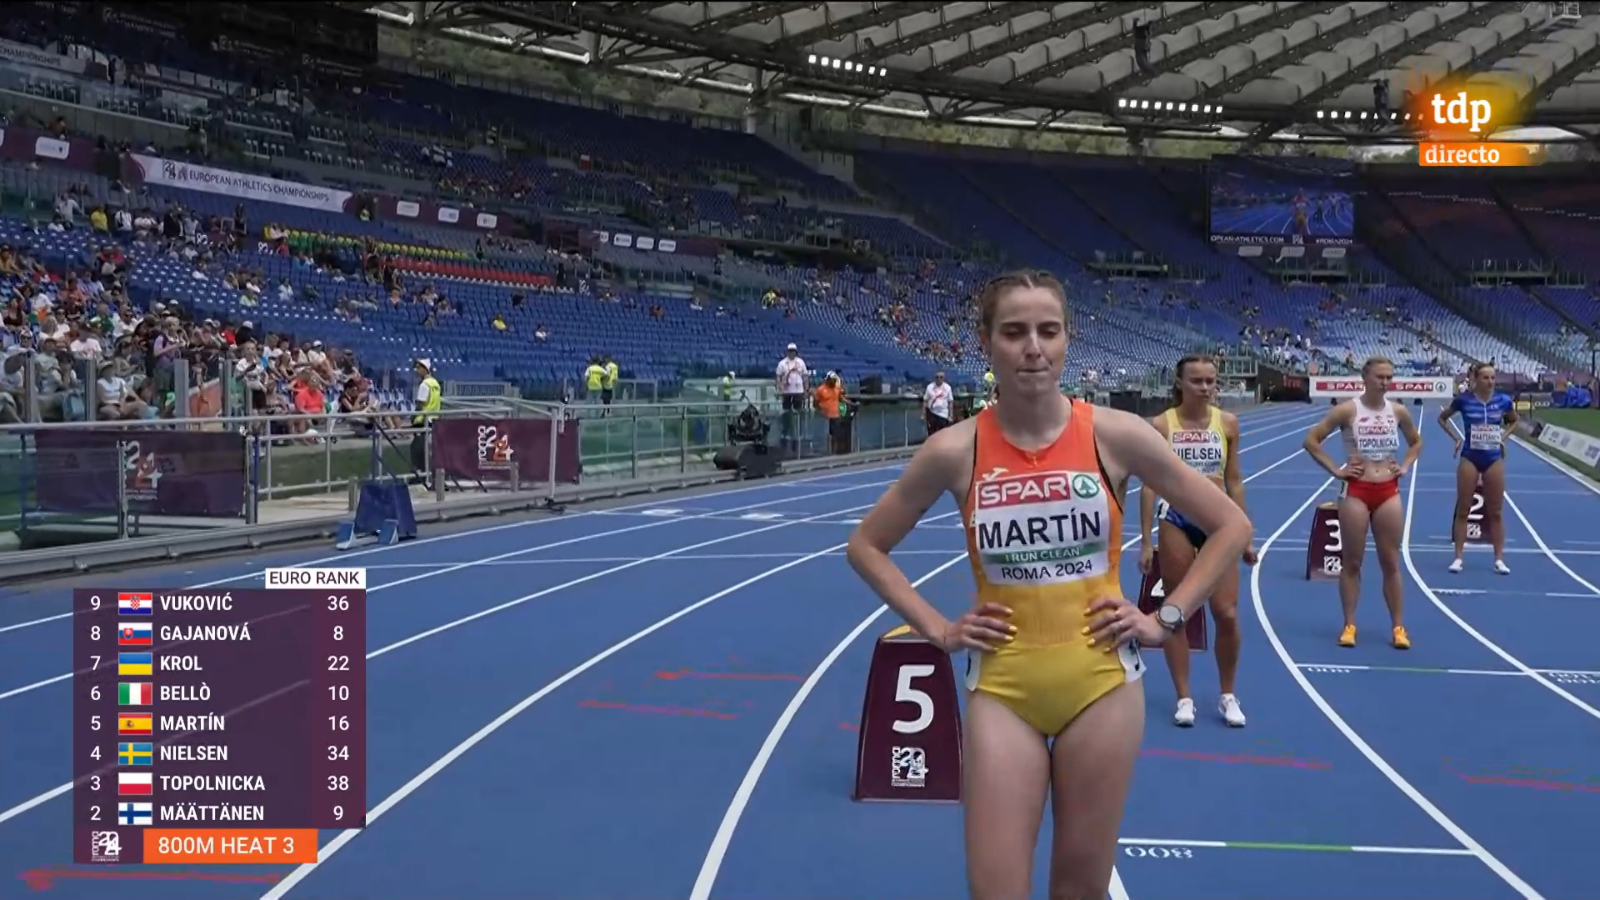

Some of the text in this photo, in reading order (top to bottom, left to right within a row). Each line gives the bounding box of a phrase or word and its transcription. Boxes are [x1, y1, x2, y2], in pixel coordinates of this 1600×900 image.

[189, 172, 330, 202] EUROPEAN ATHLETICS CHAMPIONSHIPS
[1326, 382, 1363, 391] SPAR
[1395, 382, 1433, 391] SPAR
[1173, 432, 1210, 443] SPAR
[1358, 438, 1399, 448] TOPOLNICKA
[980, 476, 1068, 505] SPAR
[979, 508, 1101, 550] MARTÍN
[1011, 551, 1038, 562] RUN
[1040, 548, 1080, 560] CLEAN
[1002, 559, 1093, 580] ROMA 2024
[892, 664, 935, 734] 5
